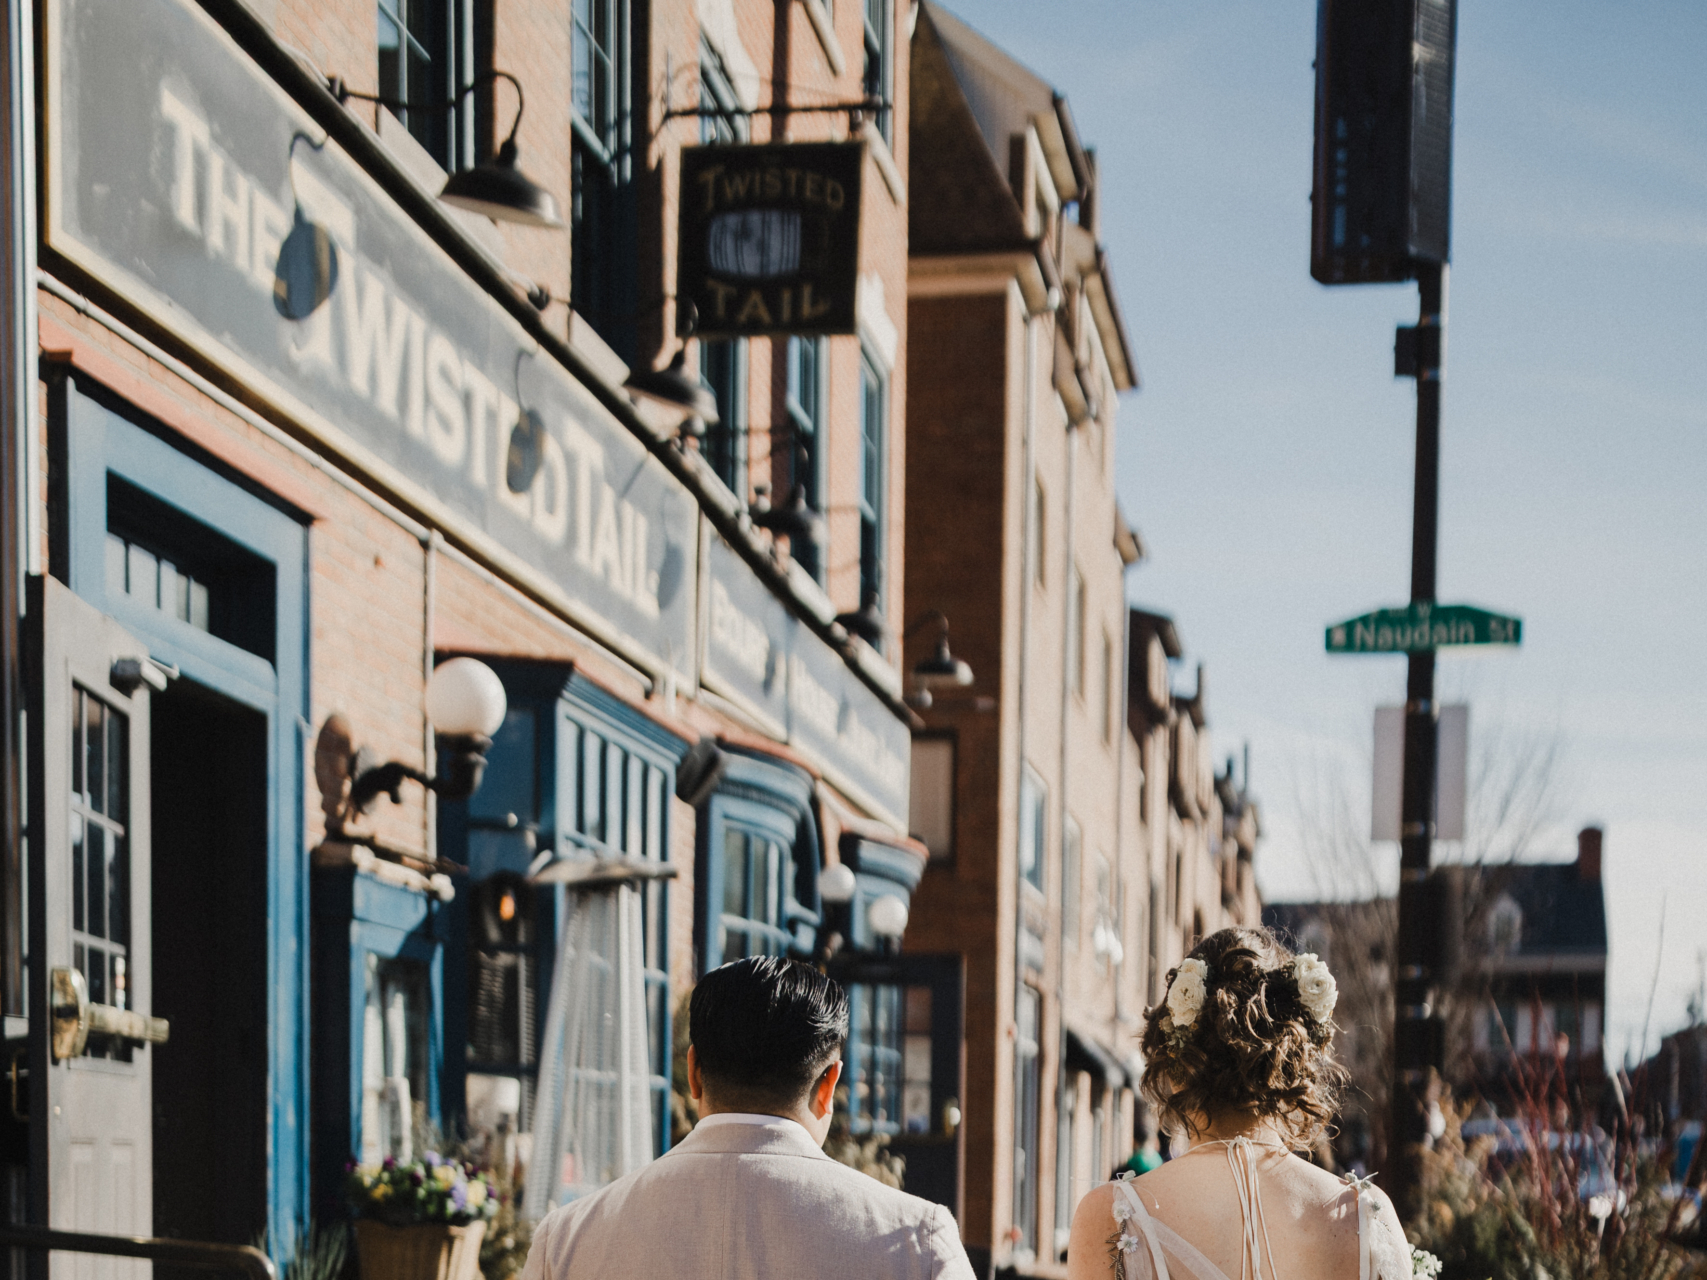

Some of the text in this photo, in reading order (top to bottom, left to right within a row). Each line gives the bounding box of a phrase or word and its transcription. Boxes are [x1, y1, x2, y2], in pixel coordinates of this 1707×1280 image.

[697, 164, 846, 213] TWISTED
[706, 277, 832, 324] TAIL
[158, 85, 661, 620] THE TWISTED TAIL
[1353, 614, 1476, 651] Naudain
